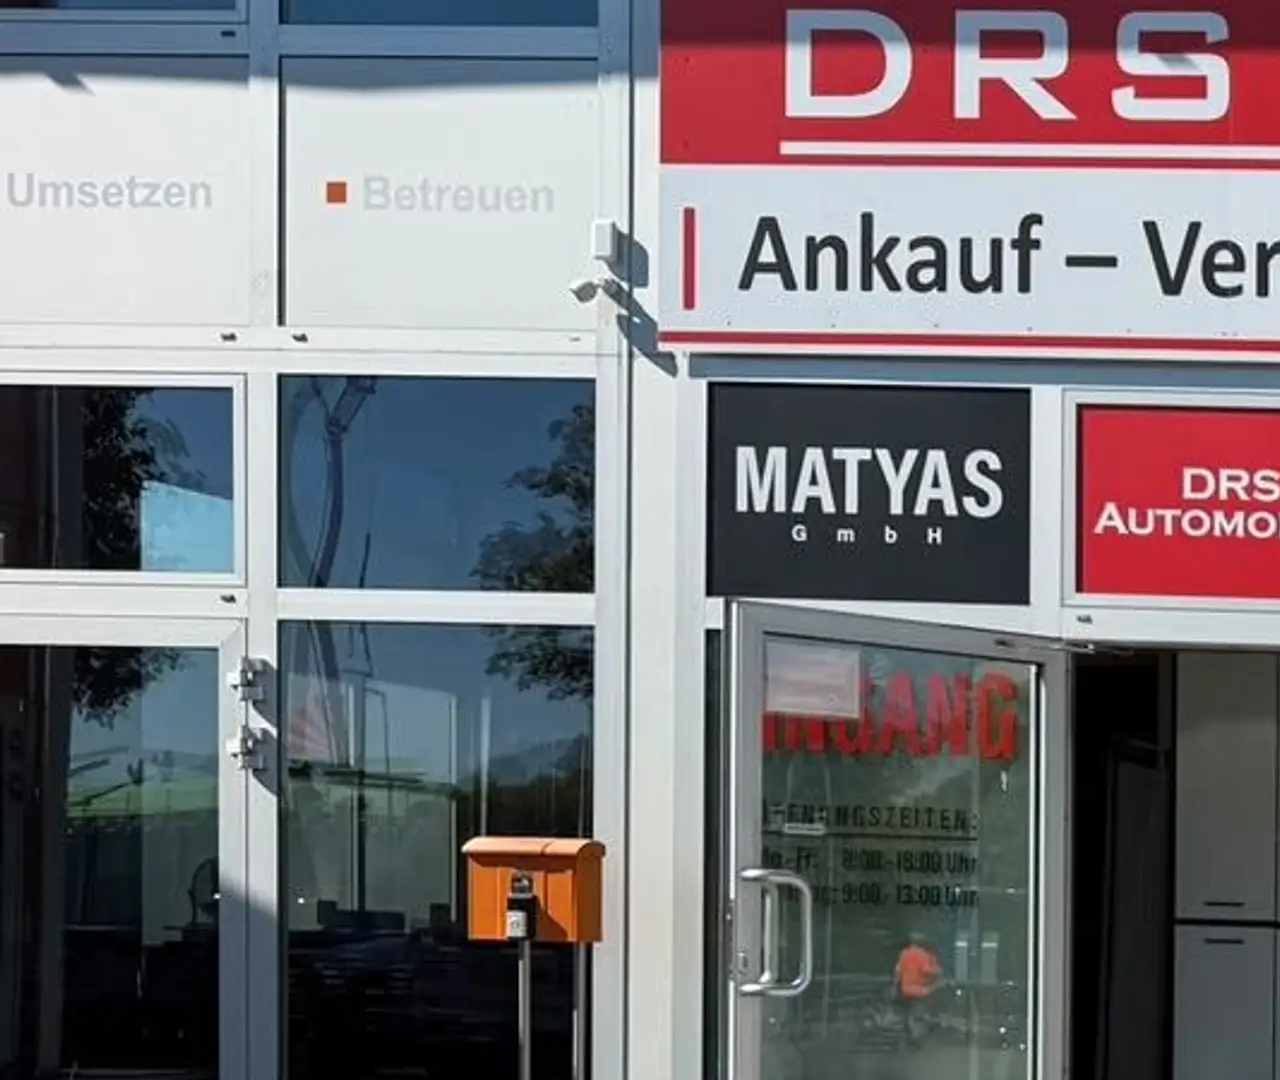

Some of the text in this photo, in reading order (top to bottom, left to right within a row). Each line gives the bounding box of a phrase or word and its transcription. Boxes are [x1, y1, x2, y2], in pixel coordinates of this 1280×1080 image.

[785, 9, 1231, 122] DRS
[5, 172, 213, 209] Umsetzen
[362, 175, 556, 214] Betreuen
[738, 211, 1043, 295] Ankauf
[735, 445, 1004, 519] MATYAS
